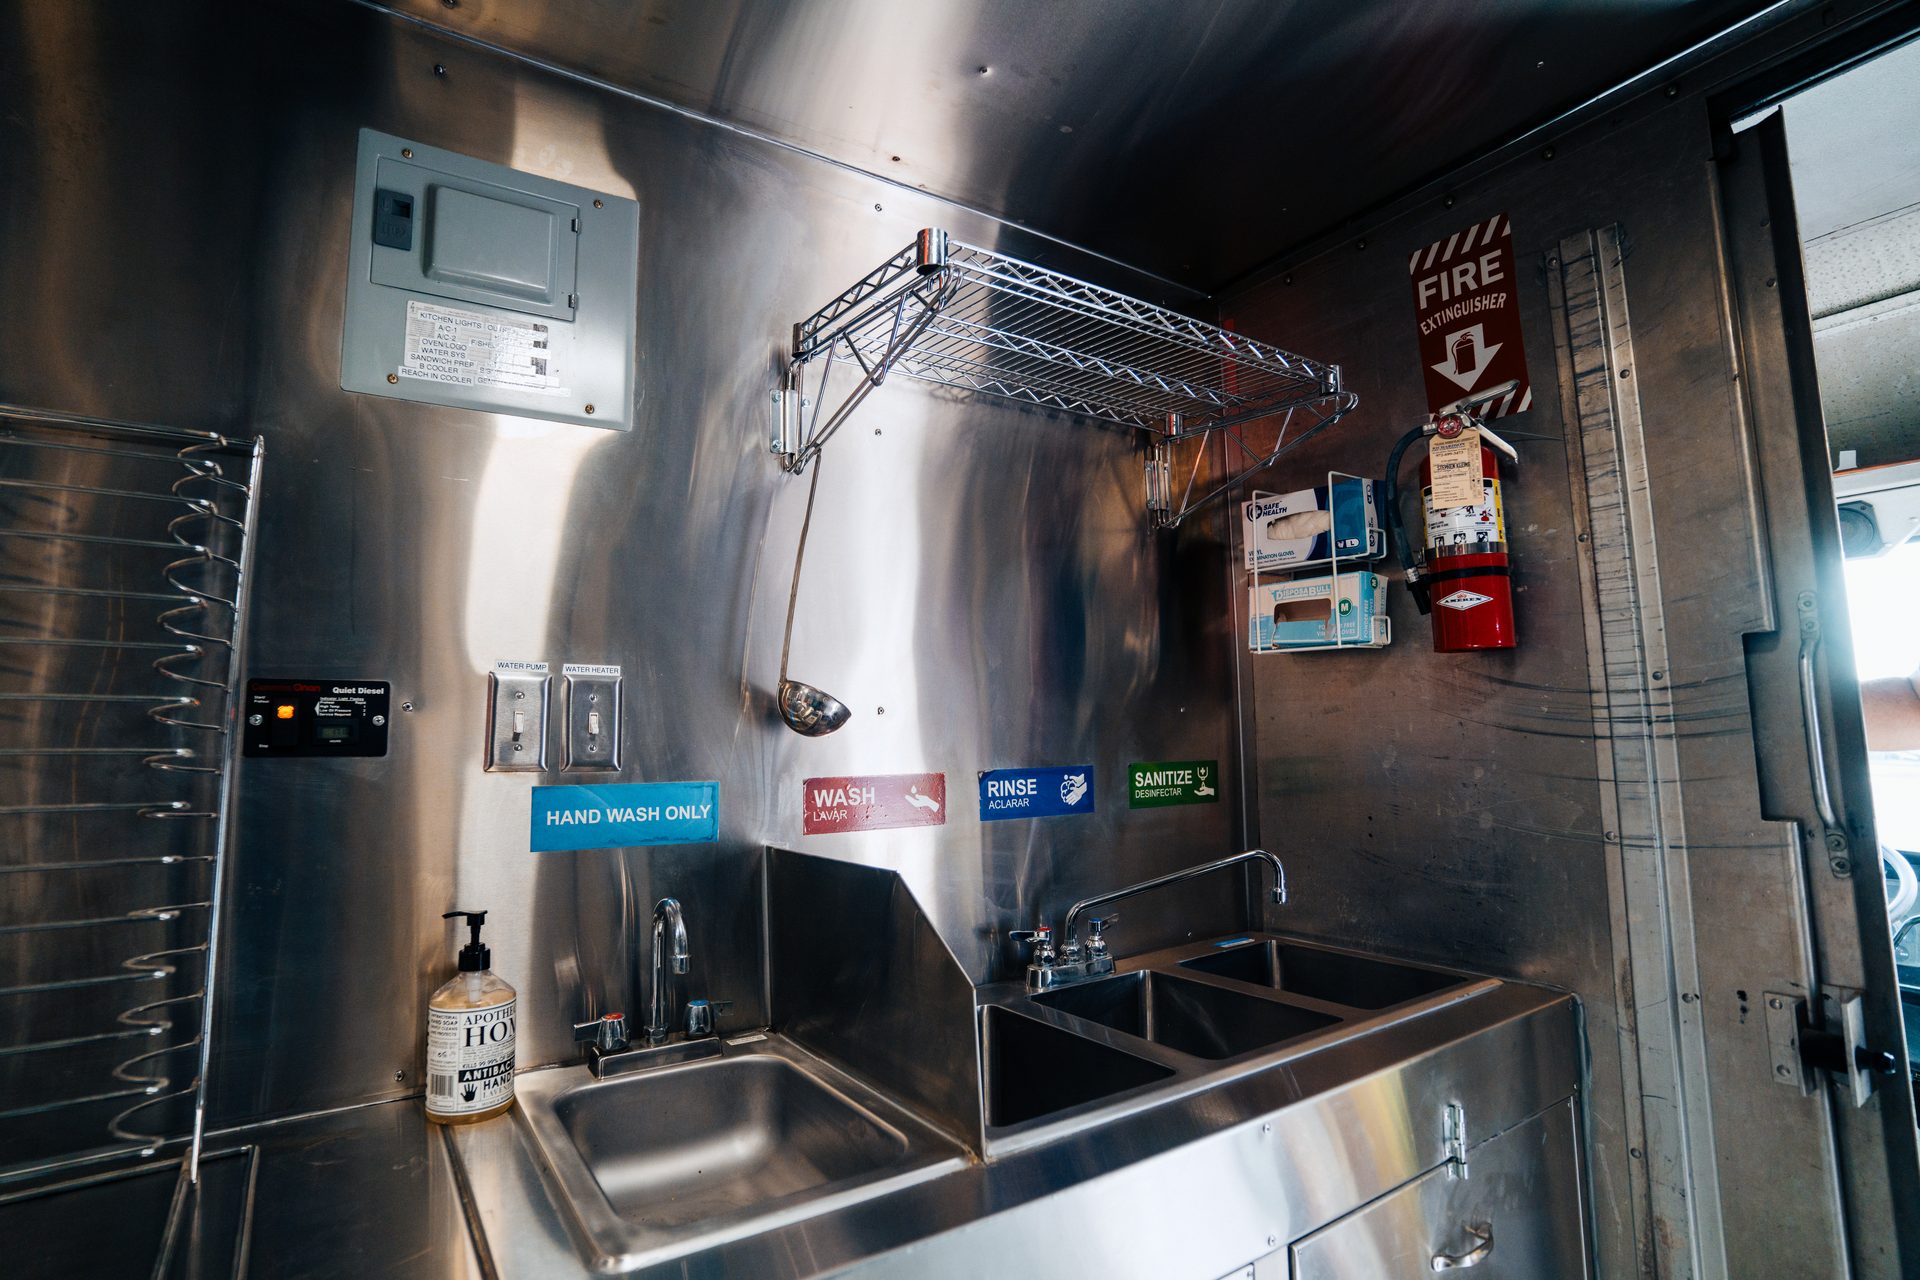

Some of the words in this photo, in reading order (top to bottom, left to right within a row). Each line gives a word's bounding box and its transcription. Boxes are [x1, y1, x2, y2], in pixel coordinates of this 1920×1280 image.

[1417, 248, 1505, 311] FIRE
[420, 312, 453, 324] KITCHEN
[455, 319, 482, 329] LIGHTS
[1420, 292, 1507, 336] EXTINGUISHER
[421, 338, 467, 351] OVEN/LOGO
[421, 347, 449, 356] WATER
[450, 351, 466, 359] SYS
[410, 353, 452, 365] SANDWICH
[454, 360, 474, 368] PREP
[426, 364, 459, 374] COOLER
[401, 368, 429, 378] REACH
[440, 374, 472, 384] COOLER
[1262, 507, 1288, 517] HEALTH
[1263, 502, 1280, 511] SAFE
[1249, 553, 1278, 562] EXMINATION
[1341, 603, 1349, 611] M
[497, 662, 525, 670] WATER
[525, 663, 547, 671] PUMP
[332, 686, 356, 694] Quiet
[357, 687, 385, 695] Diesel
[1135, 770, 1193, 787] SANITIZE
[987, 778, 1038, 798] RINSE
[1135, 787, 1182, 799] DESINFECTAR
[813, 786, 876, 808] WASH
[988, 797, 1030, 810] ACLARAR
[546, 809, 602, 826] HAND
[606, 807, 660, 823] WASH
[665, 804, 712, 820] ONLY
[812, 809, 848, 822] LAVAR
[483, 1072, 511, 1091] HAND
